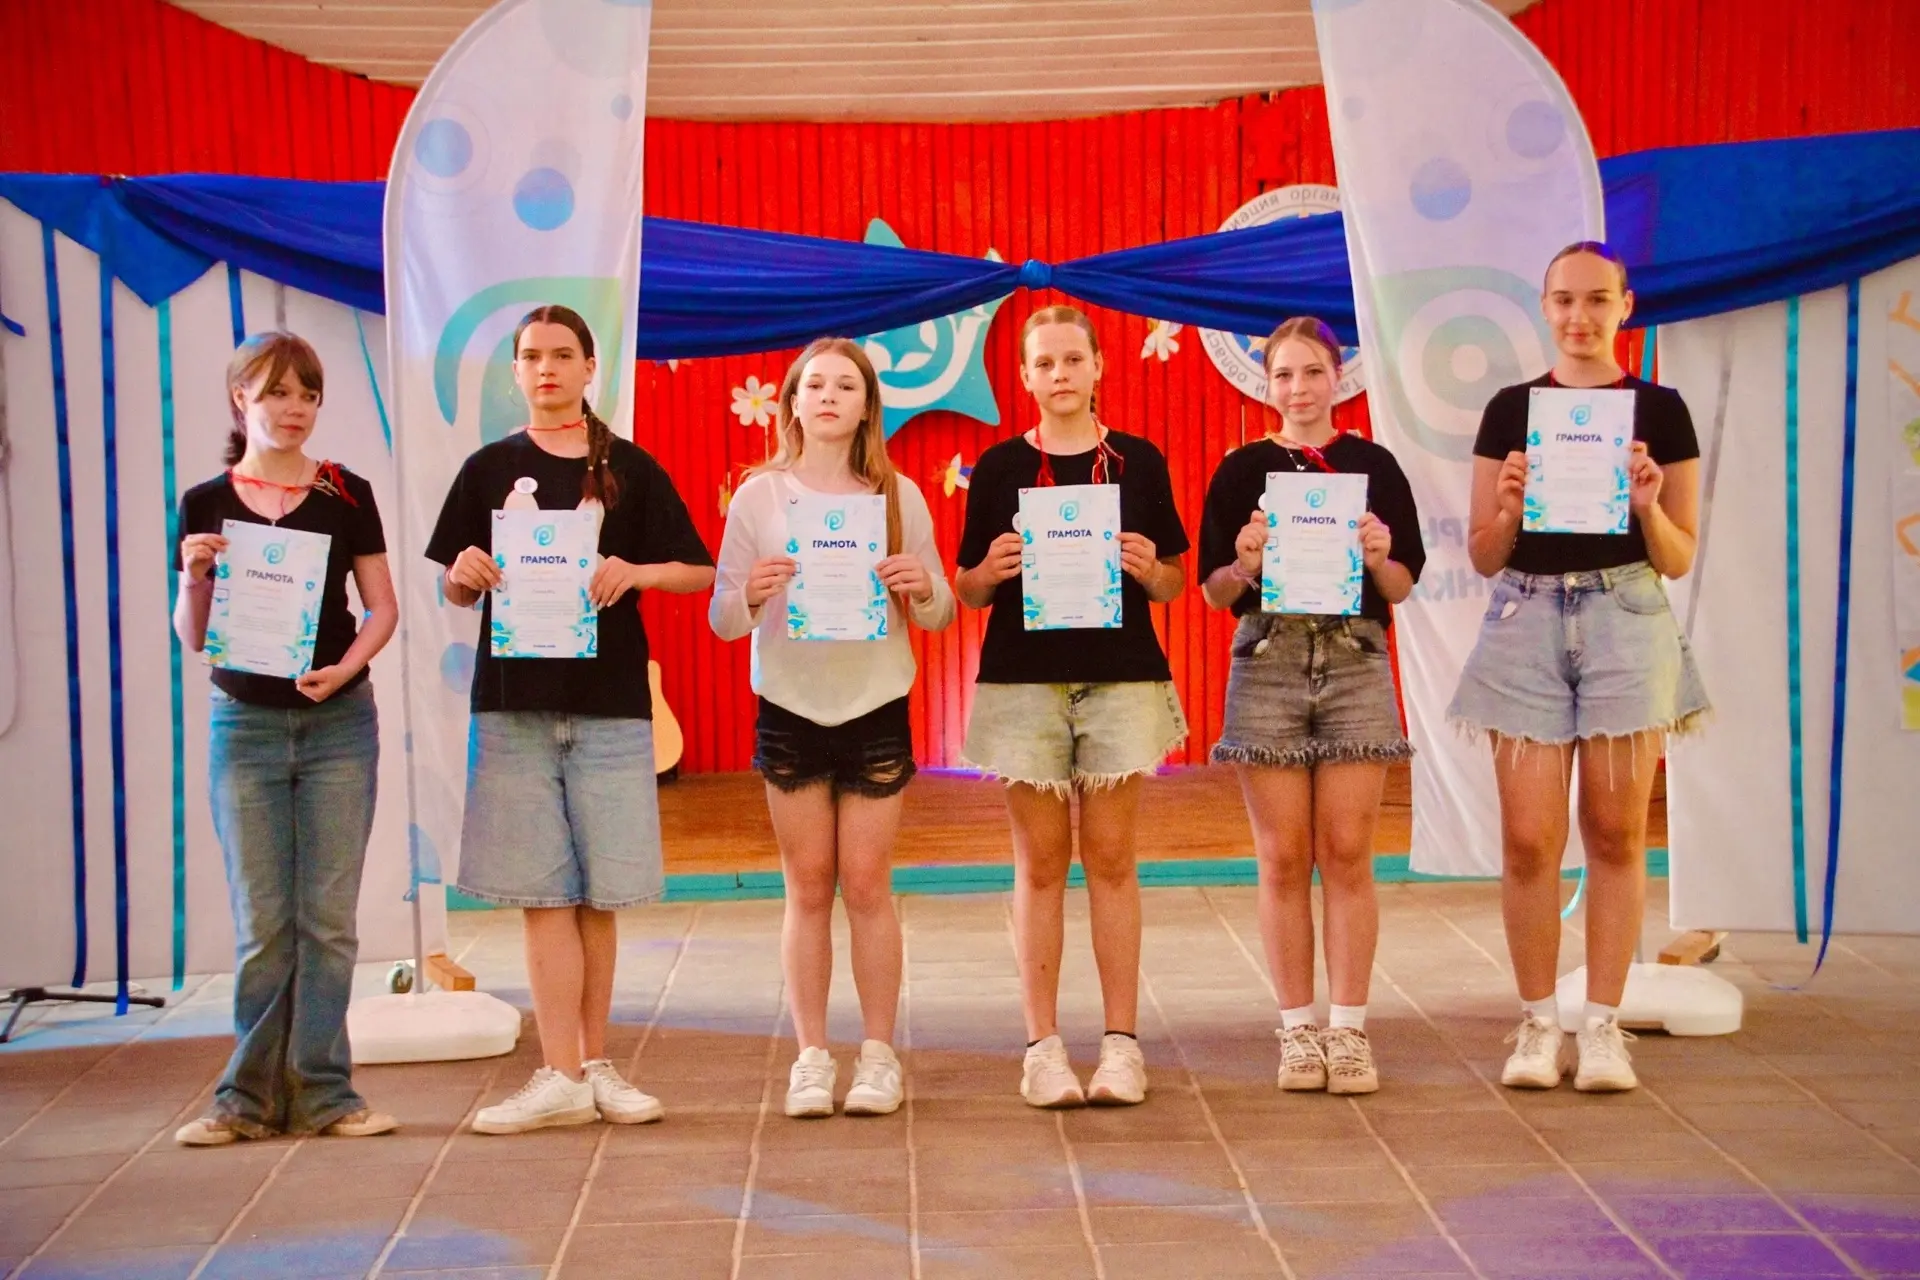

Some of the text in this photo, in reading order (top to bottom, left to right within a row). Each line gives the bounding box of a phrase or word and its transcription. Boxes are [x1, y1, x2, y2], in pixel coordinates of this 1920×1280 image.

[1556, 433, 1602, 443] ГРАМОТА
[1291, 515, 1337, 525] ГРАМОТА
[1047, 529, 1092, 539] ГРАМОТА
[812, 540, 857, 549] ГРАМОТА
[520, 556, 567, 564] ГРАМОТА
[246, 569, 294, 584] ГРАМОТА
